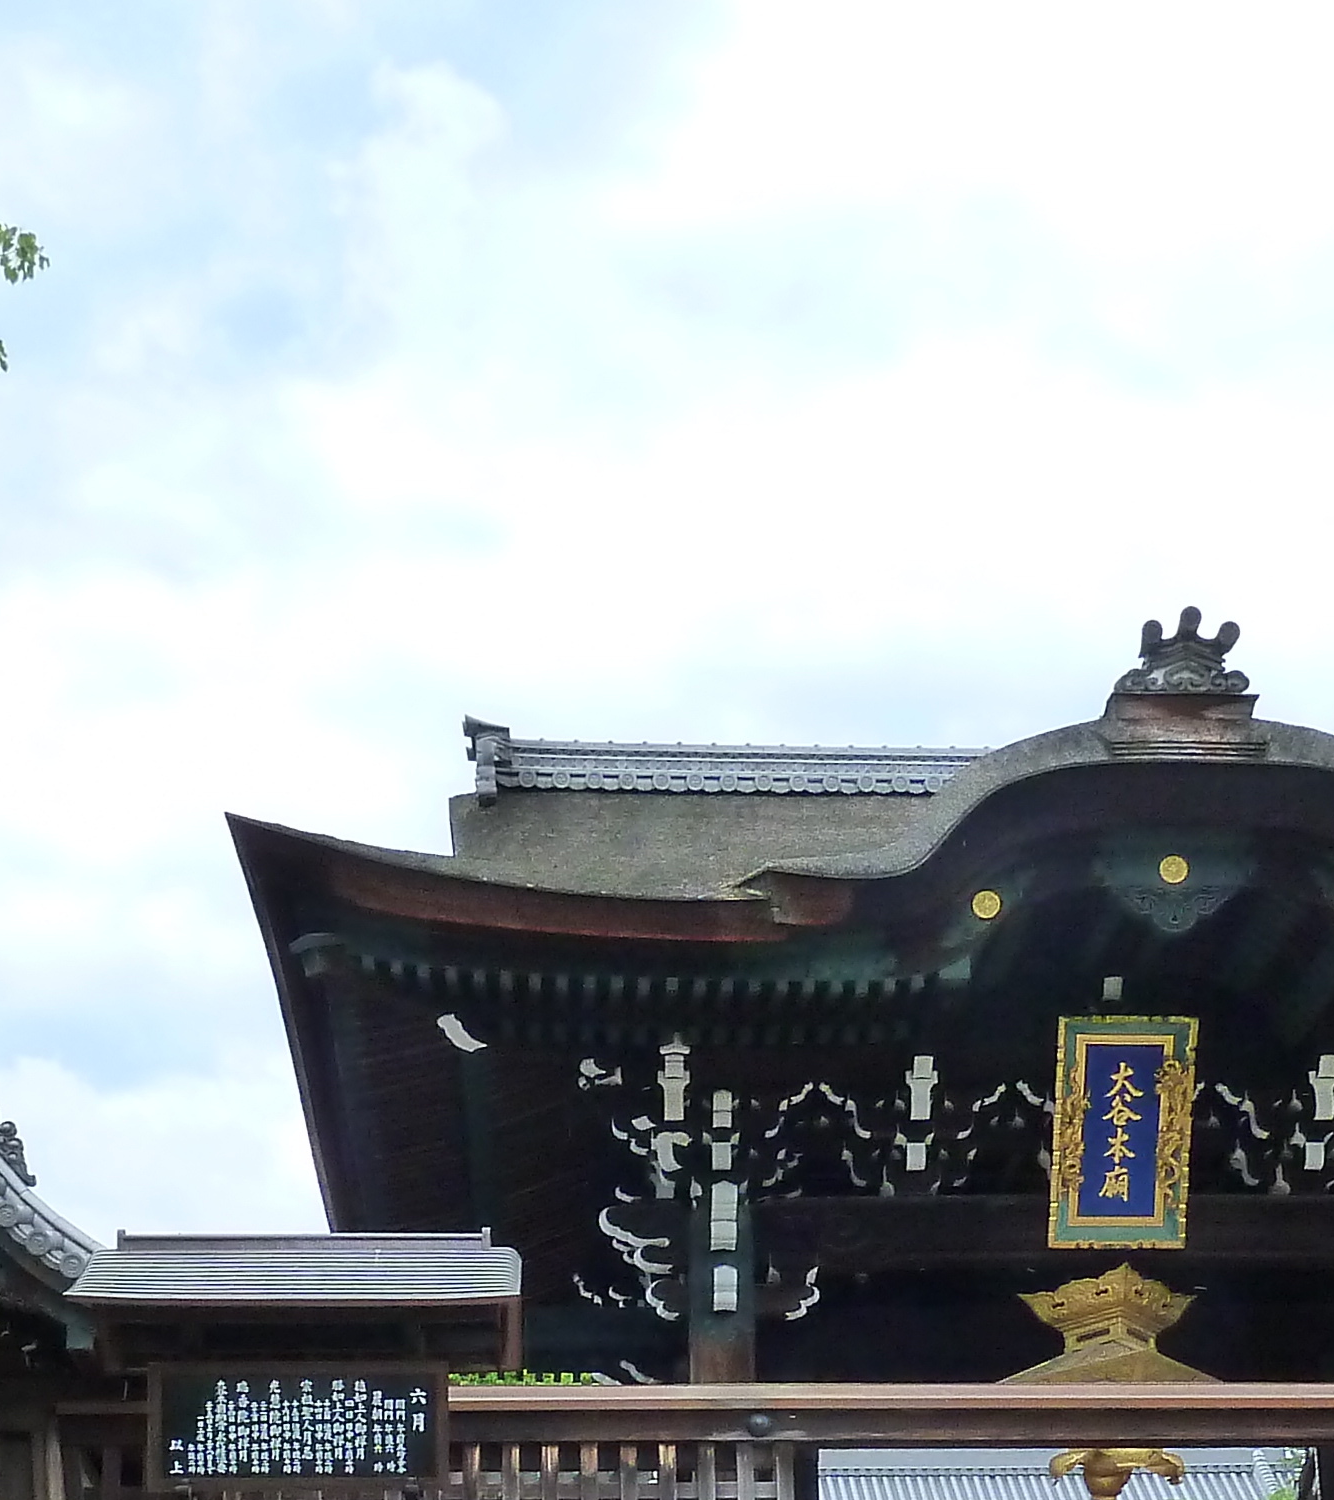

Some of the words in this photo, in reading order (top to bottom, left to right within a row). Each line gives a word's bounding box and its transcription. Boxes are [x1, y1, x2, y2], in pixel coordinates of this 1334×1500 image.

[1098, 1061, 1144, 1202] 大谷本廟
[409, 1387, 426, 1432] 六月
[169, 1439, 184, 1475] 以上
